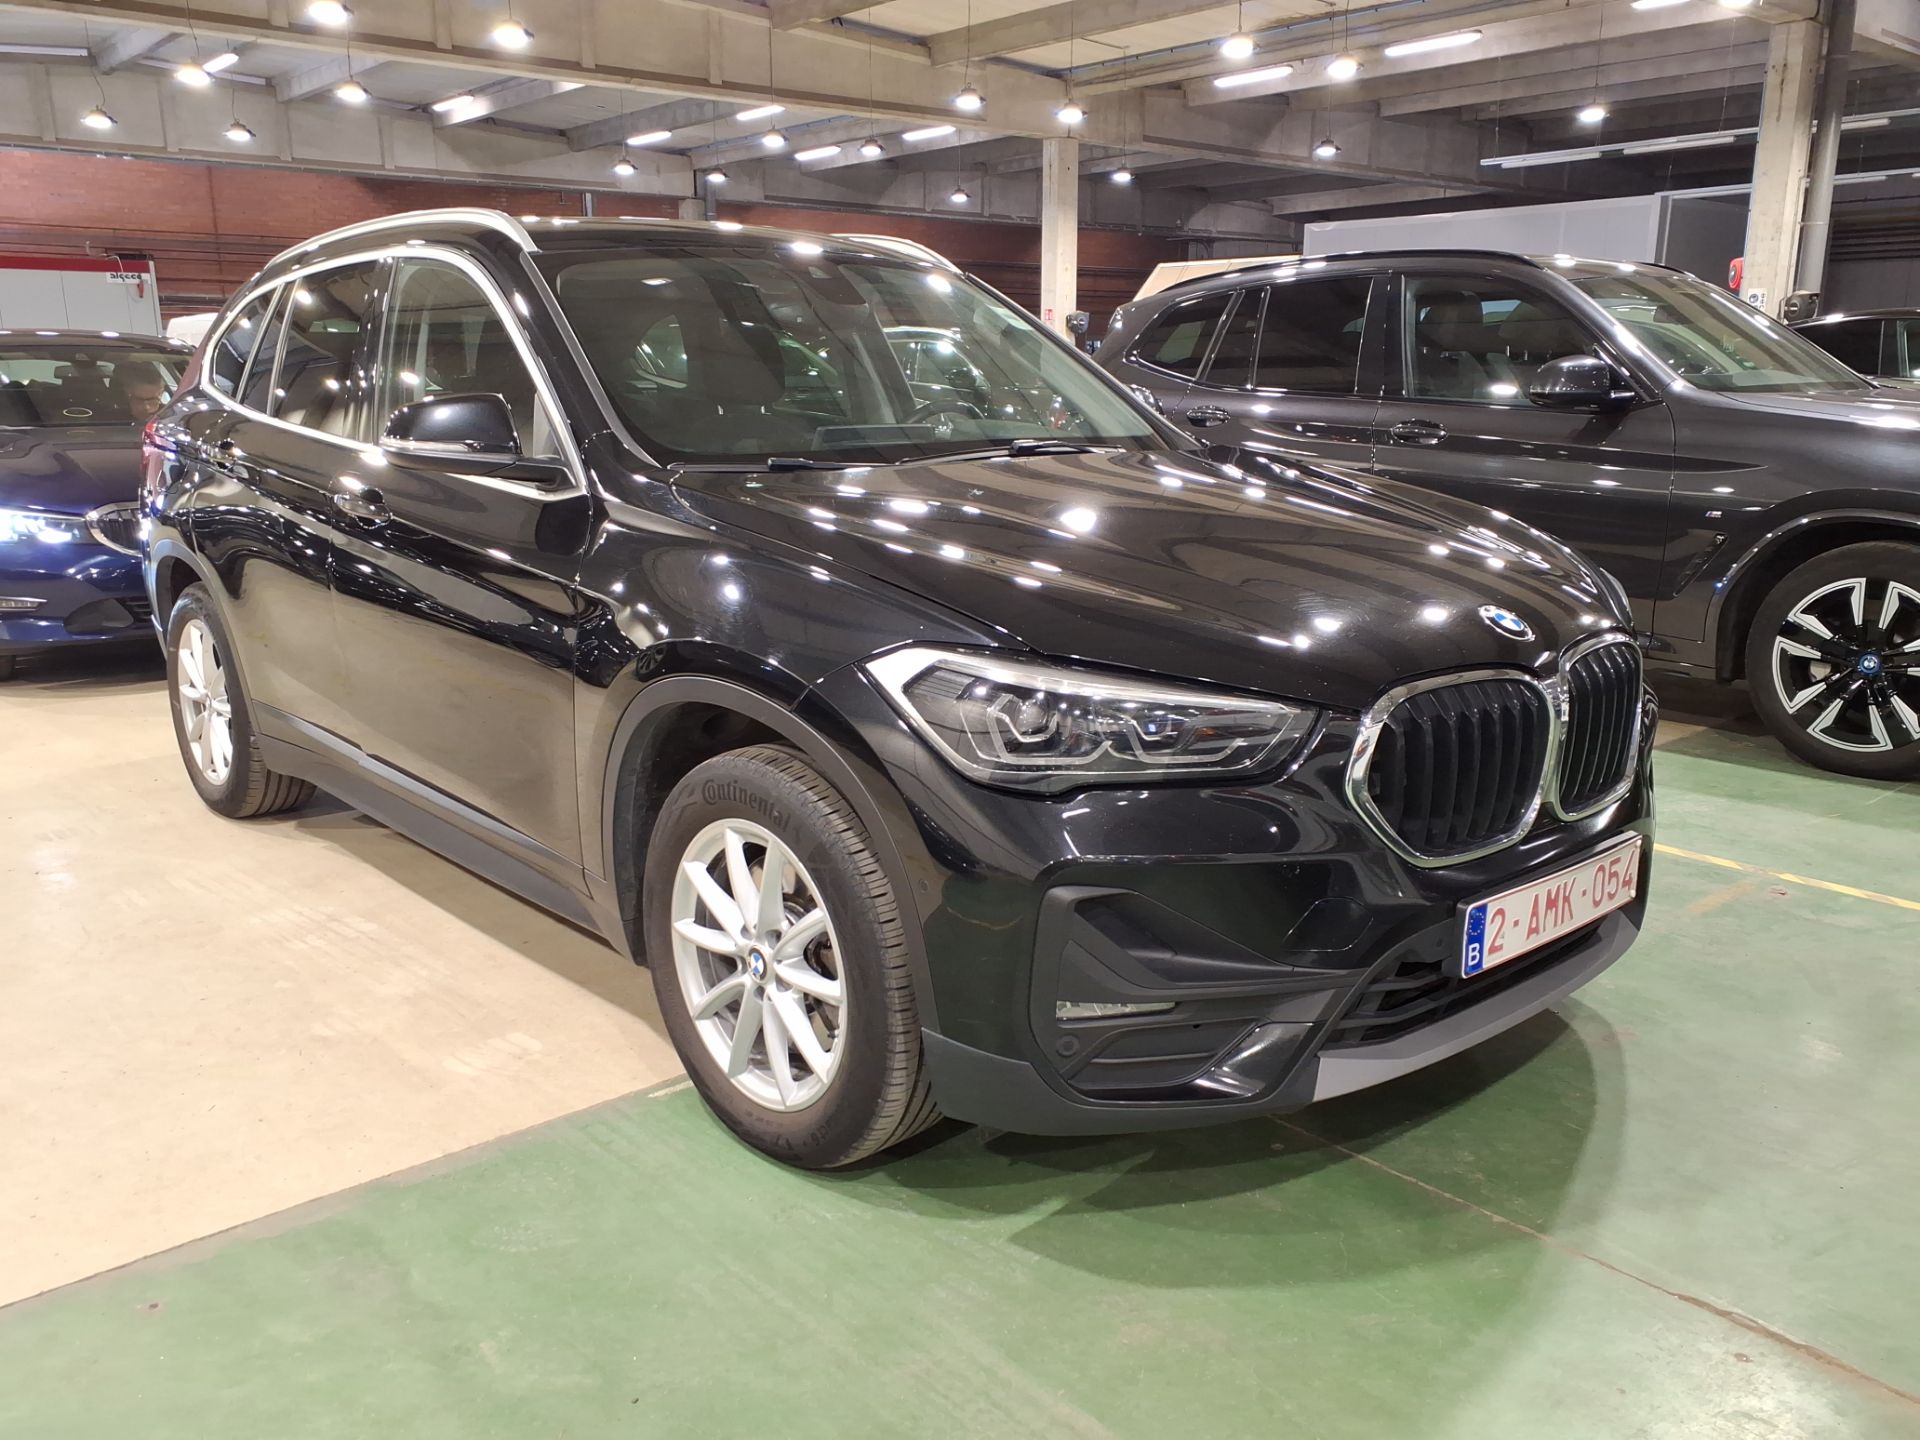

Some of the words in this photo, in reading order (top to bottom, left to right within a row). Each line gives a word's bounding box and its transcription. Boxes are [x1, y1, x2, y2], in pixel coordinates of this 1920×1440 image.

[702, 779, 791, 832] Continental
[1487, 850, 1636, 956] 2-AMK-054
[1467, 943, 1480, 966] B
